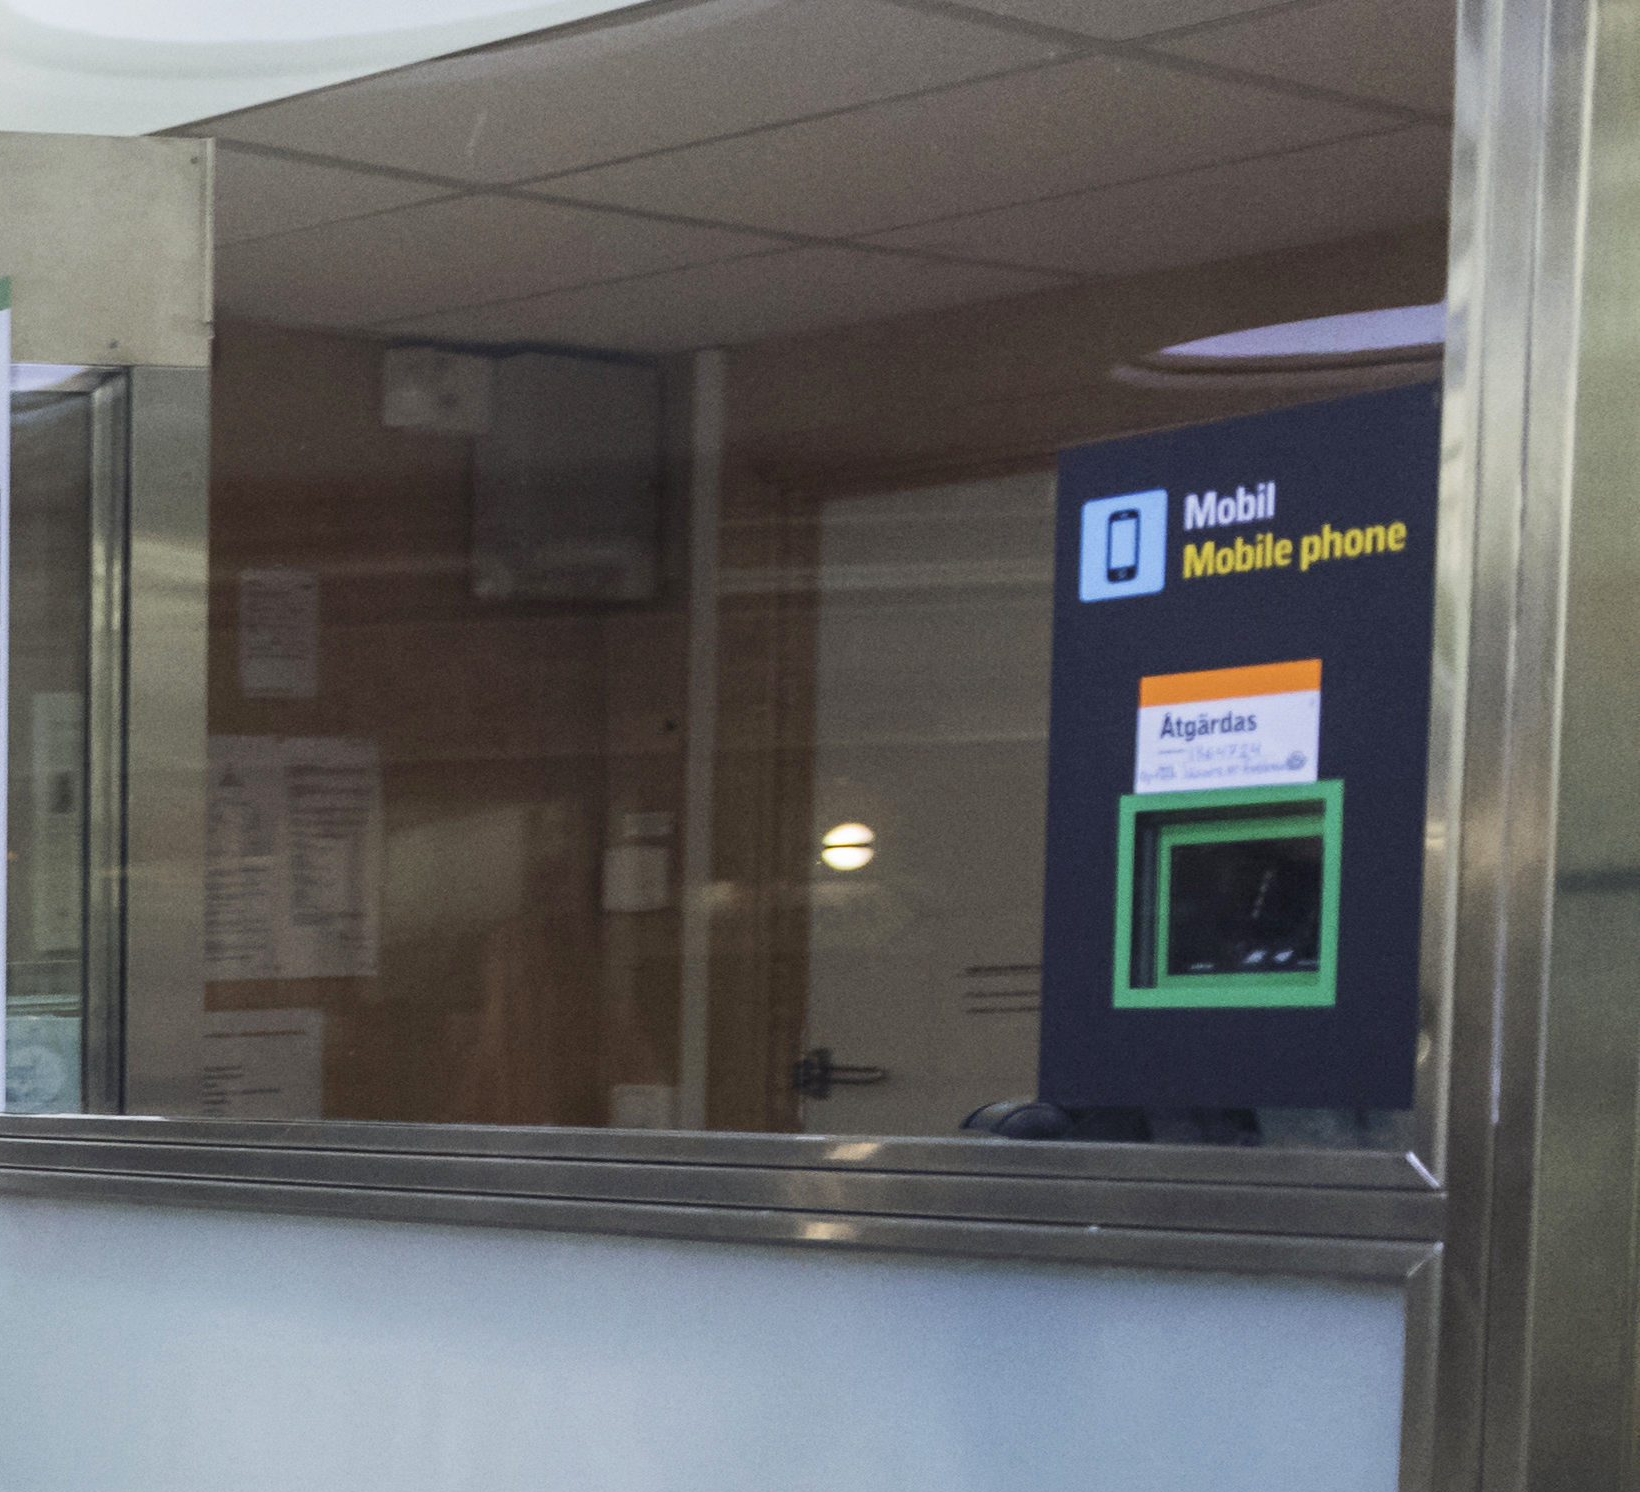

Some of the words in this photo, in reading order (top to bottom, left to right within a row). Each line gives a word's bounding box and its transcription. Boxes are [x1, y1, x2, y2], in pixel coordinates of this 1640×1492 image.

[1183, 480, 1276, 531] Mobil
[1182, 532, 1294, 579] Mobile
[1299, 521, 1408, 572] phone
[1160, 711, 1258, 741] Åtgärdas
